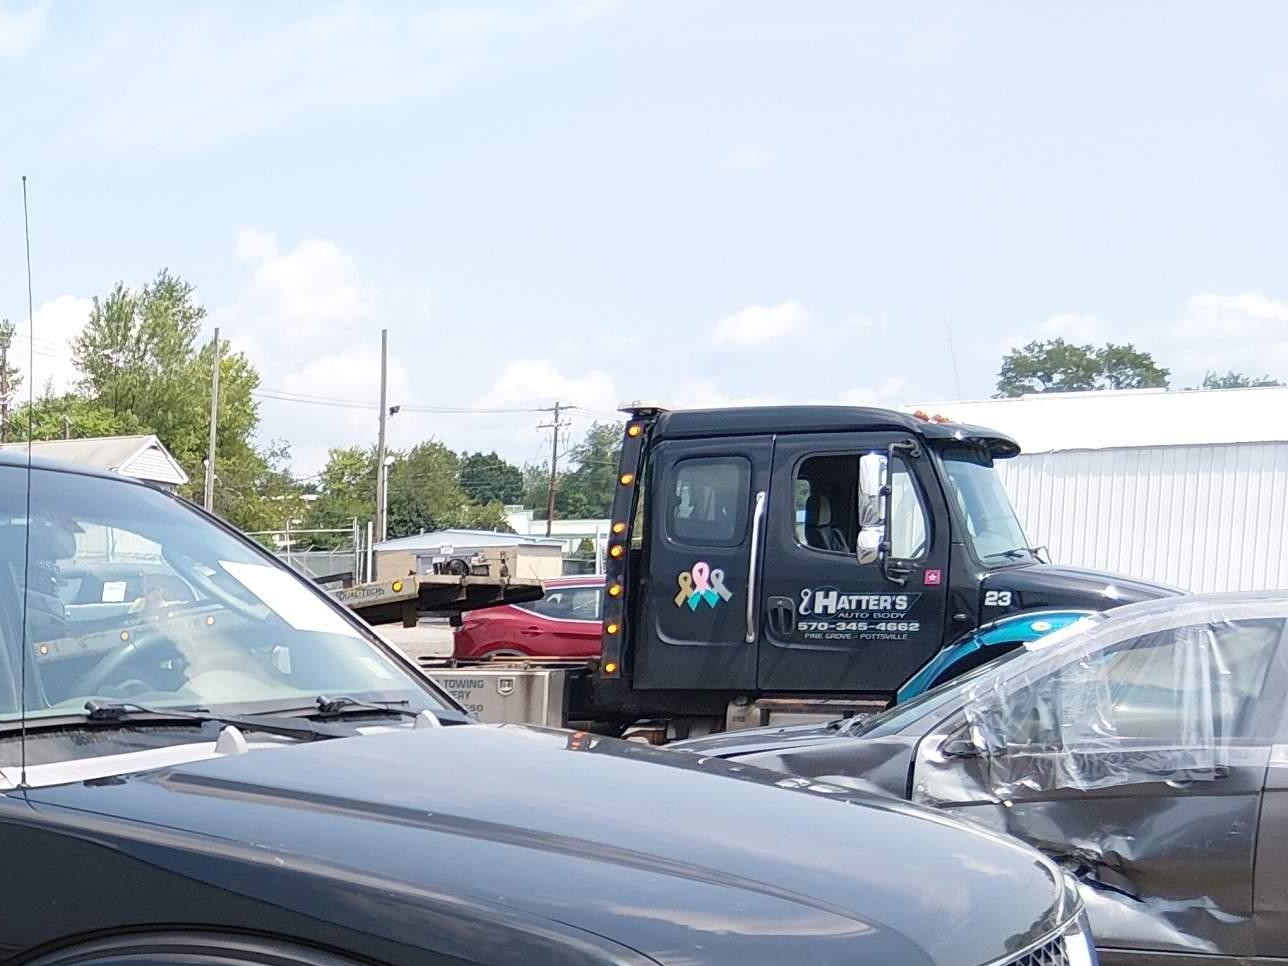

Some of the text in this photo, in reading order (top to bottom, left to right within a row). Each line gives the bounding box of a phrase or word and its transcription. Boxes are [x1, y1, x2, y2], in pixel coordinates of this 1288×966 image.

[814, 591, 908, 614] HATTER'S
[984, 590, 1012, 606] 23
[798, 622, 920, 631] 570-345-4662
[443, 679, 484, 688] TOWING
[449, 690, 472, 700] ERY
